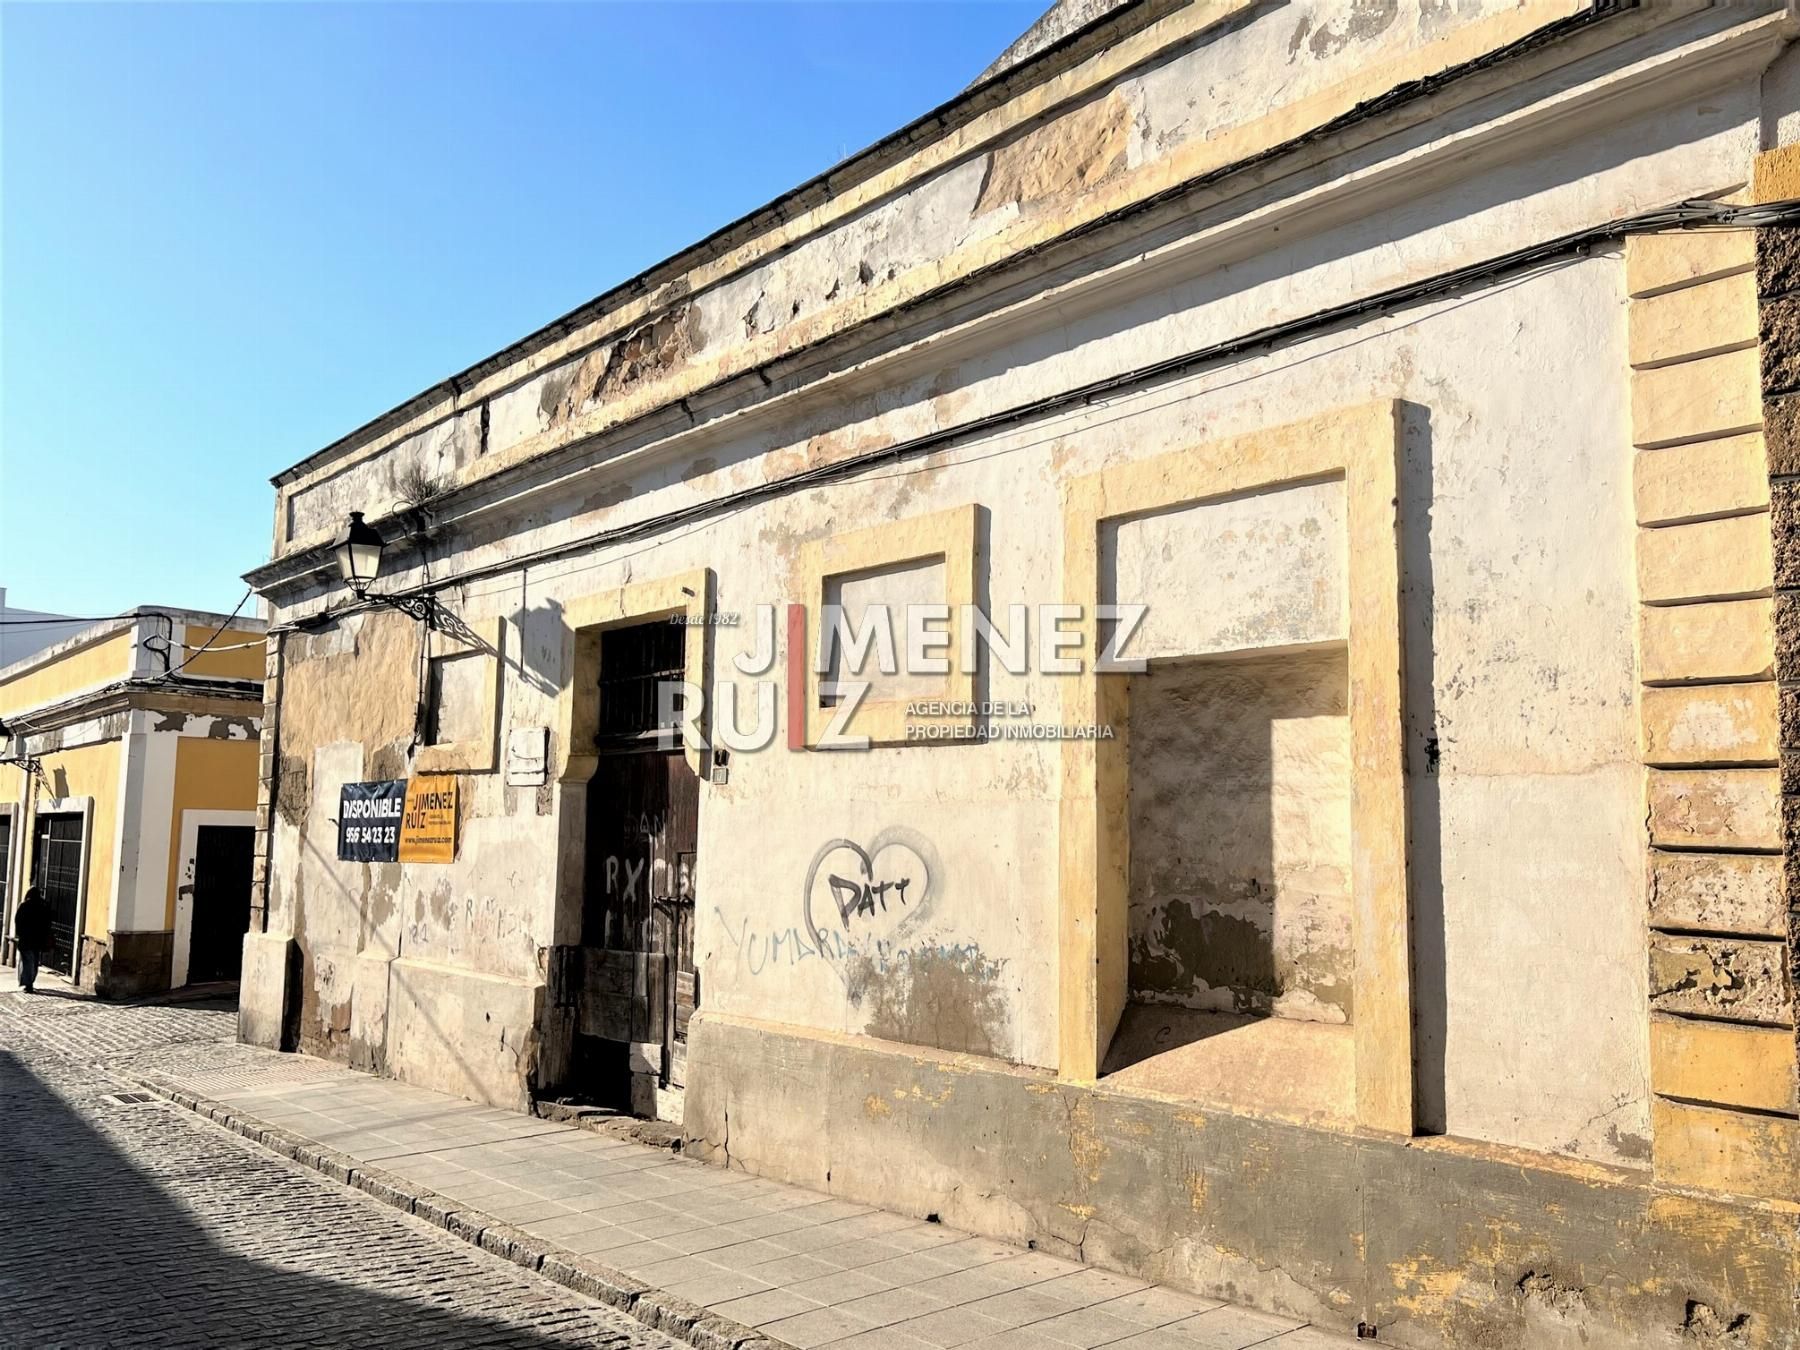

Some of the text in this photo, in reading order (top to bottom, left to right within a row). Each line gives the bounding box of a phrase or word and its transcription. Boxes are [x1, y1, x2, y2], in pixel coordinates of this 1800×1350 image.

[343, 798, 401, 818] DISPONIBLE
[413, 792, 453, 810] JIMENEZ
[406, 812, 426, 829] RUIZ
[345, 826, 396, 844] 956 54 23 23
